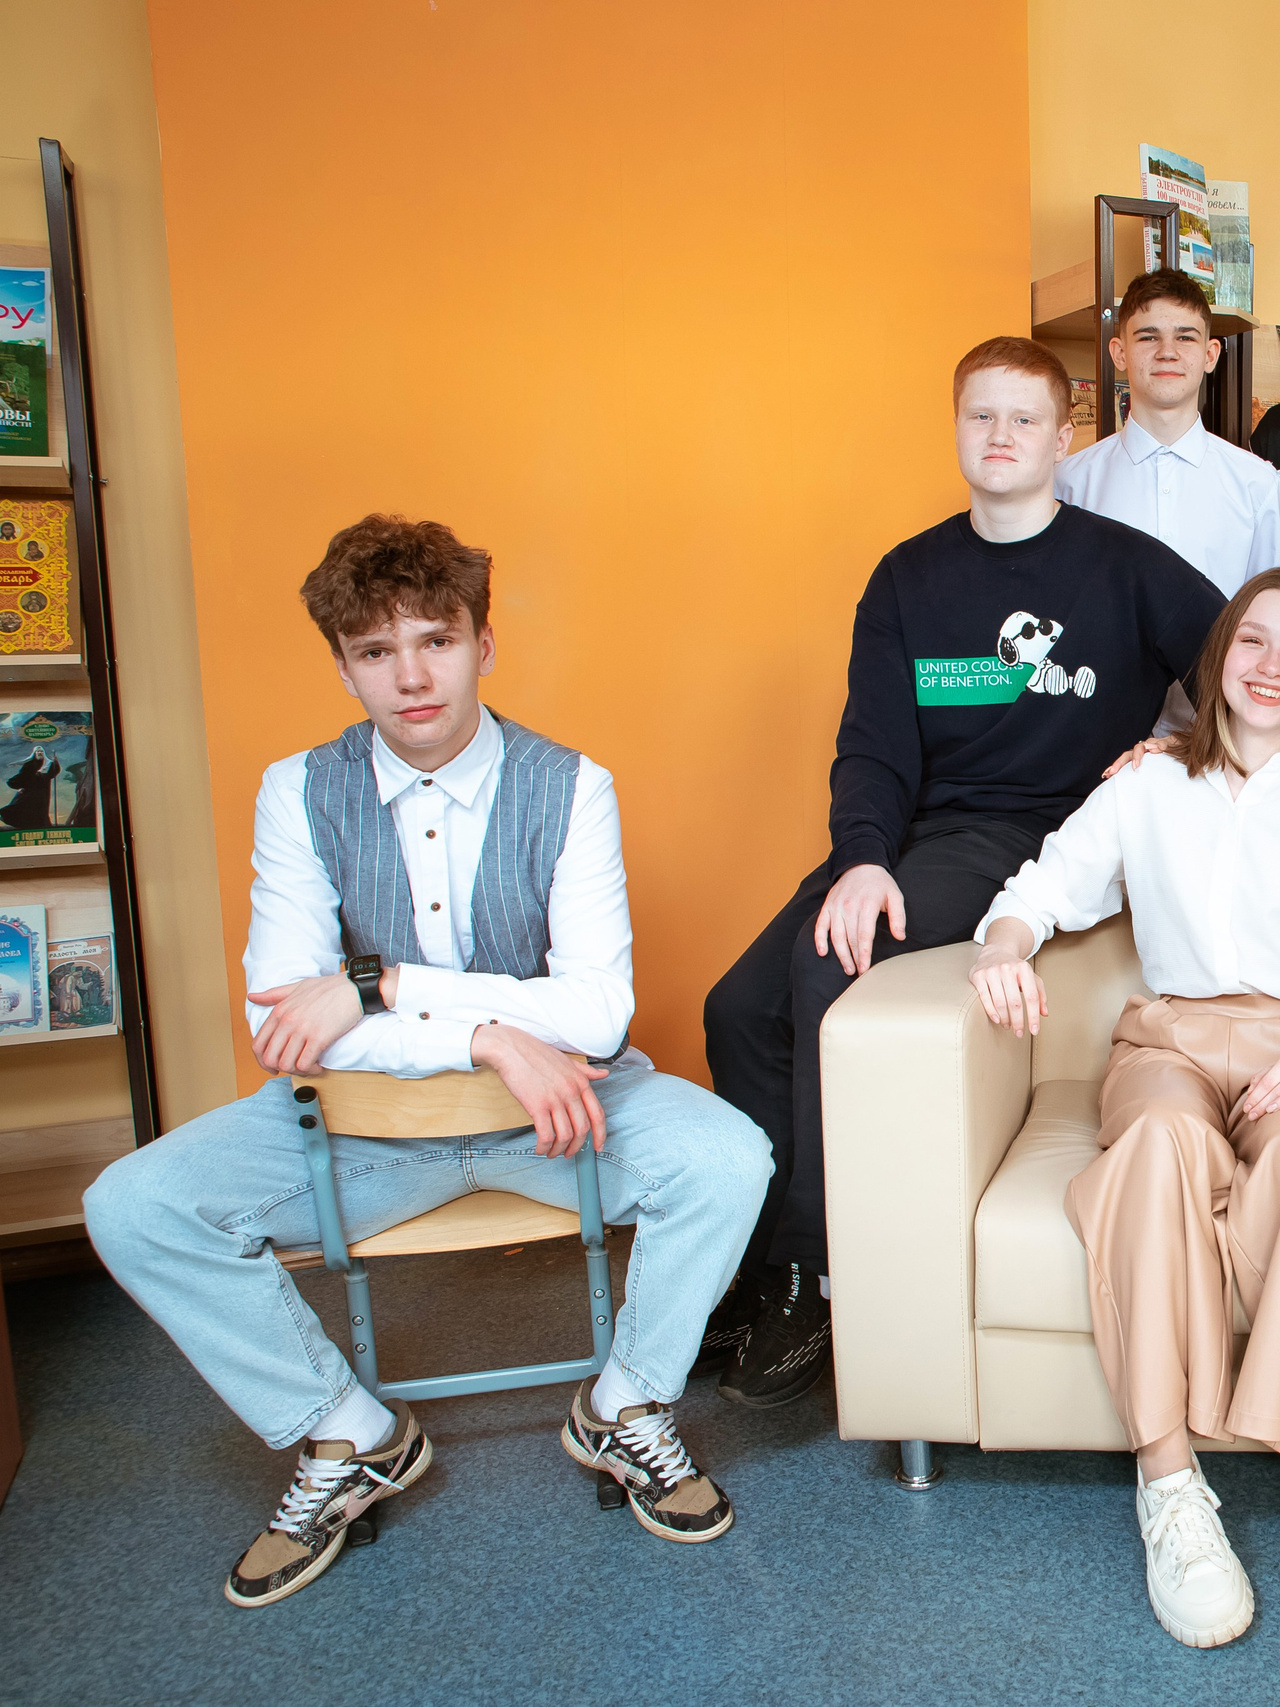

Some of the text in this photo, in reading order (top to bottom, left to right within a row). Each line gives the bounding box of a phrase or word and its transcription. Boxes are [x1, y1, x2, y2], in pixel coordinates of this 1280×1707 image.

[1156, 178, 1204, 203] ЭЛЕКТРОУГЛИ
[1156, 190, 1168, 201] 100
[919, 661, 968, 674] UNITED
[919, 674, 1013, 687] OF BENETTON.
